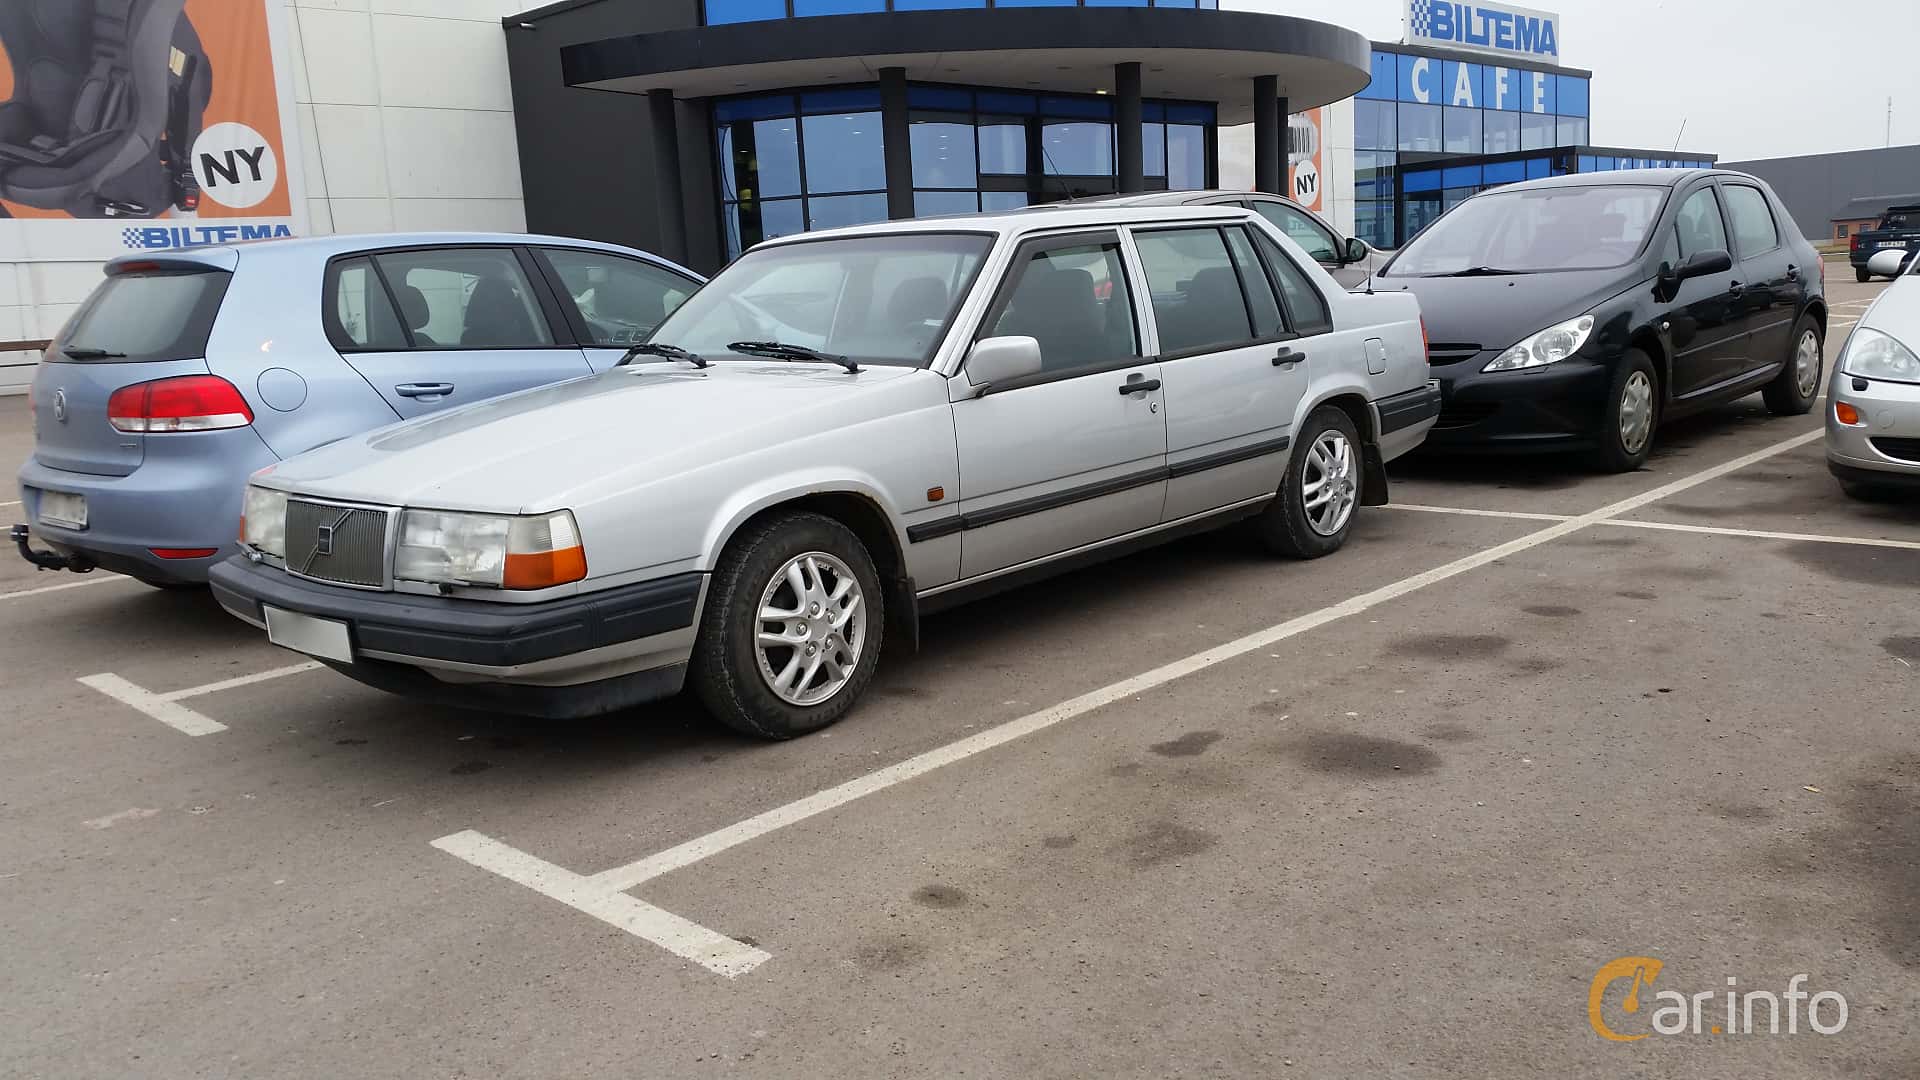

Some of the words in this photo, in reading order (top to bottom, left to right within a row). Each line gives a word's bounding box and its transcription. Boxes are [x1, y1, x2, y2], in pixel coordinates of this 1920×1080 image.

[1430, 0, 1558, 56] BILTEMA
[1411, 58, 1545, 113] CAFE
[200, 146, 265, 187] NY
[1296, 173, 1316, 195] NY
